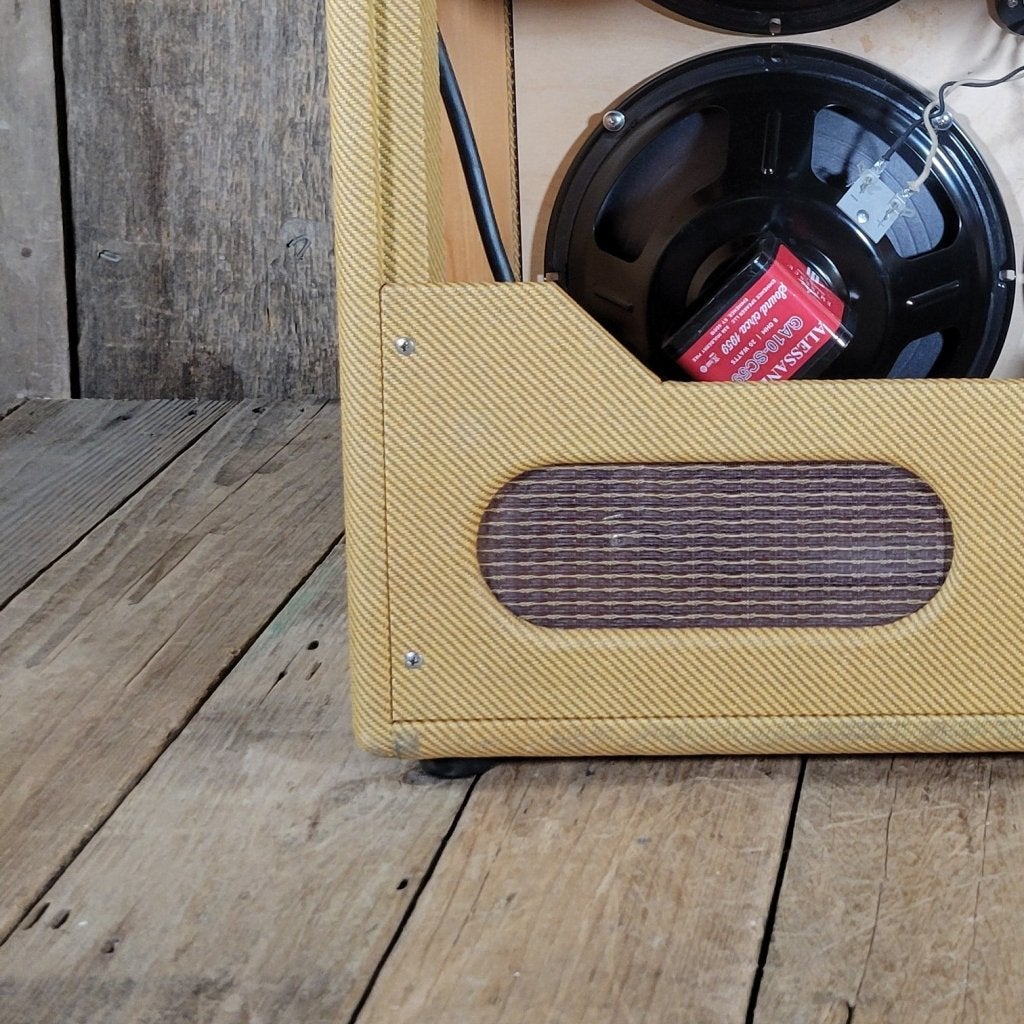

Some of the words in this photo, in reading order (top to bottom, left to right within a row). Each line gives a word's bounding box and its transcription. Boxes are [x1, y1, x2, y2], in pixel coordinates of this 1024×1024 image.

[757, 282, 789, 319] Sound
[738, 310, 761, 334] circa
[721, 331, 741, 354] 1959
[760, 321, 825, 381] ALESSAN
[730, 345, 750, 365] WATTS
